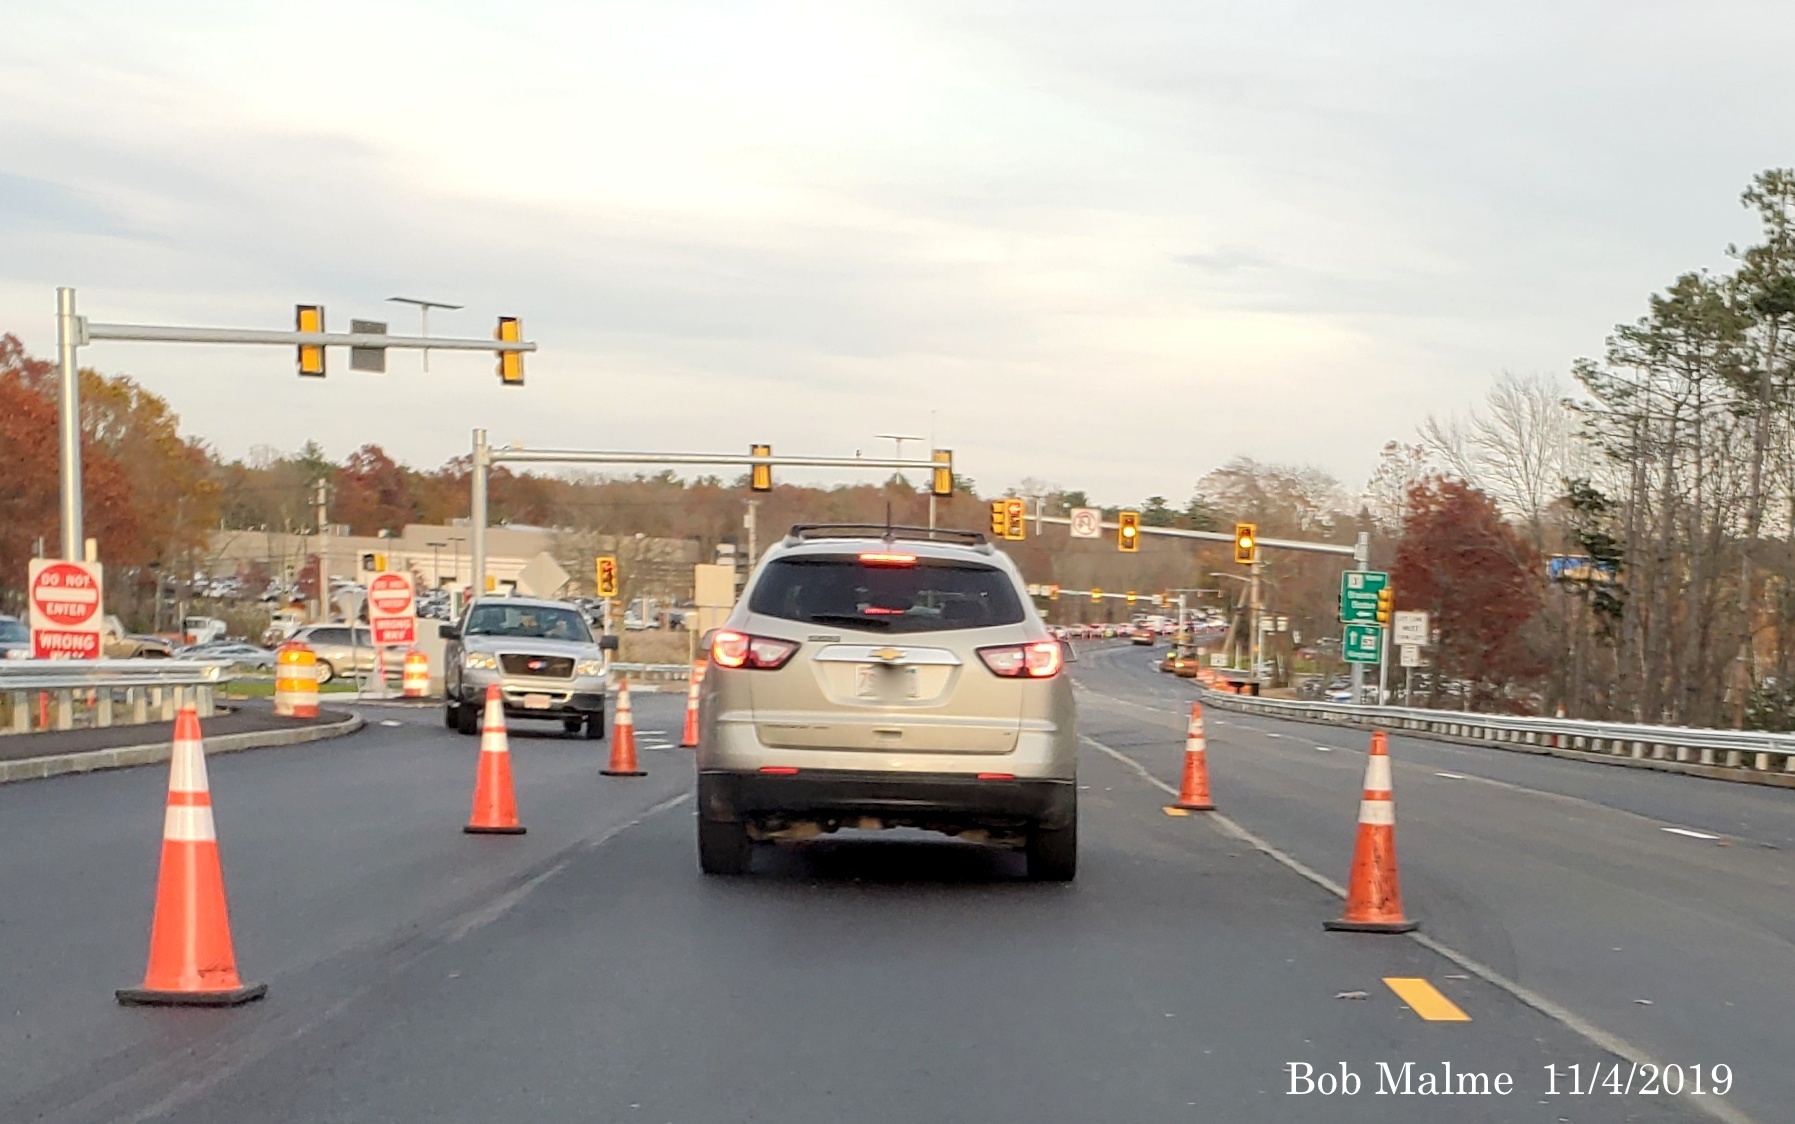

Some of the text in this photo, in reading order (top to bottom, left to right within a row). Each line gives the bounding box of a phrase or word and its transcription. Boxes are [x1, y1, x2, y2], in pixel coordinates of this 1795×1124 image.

[41, 572, 91, 588] DO NOT
[46, 602, 87, 617] ENTER
[39, 632, 96, 651] WRONG
